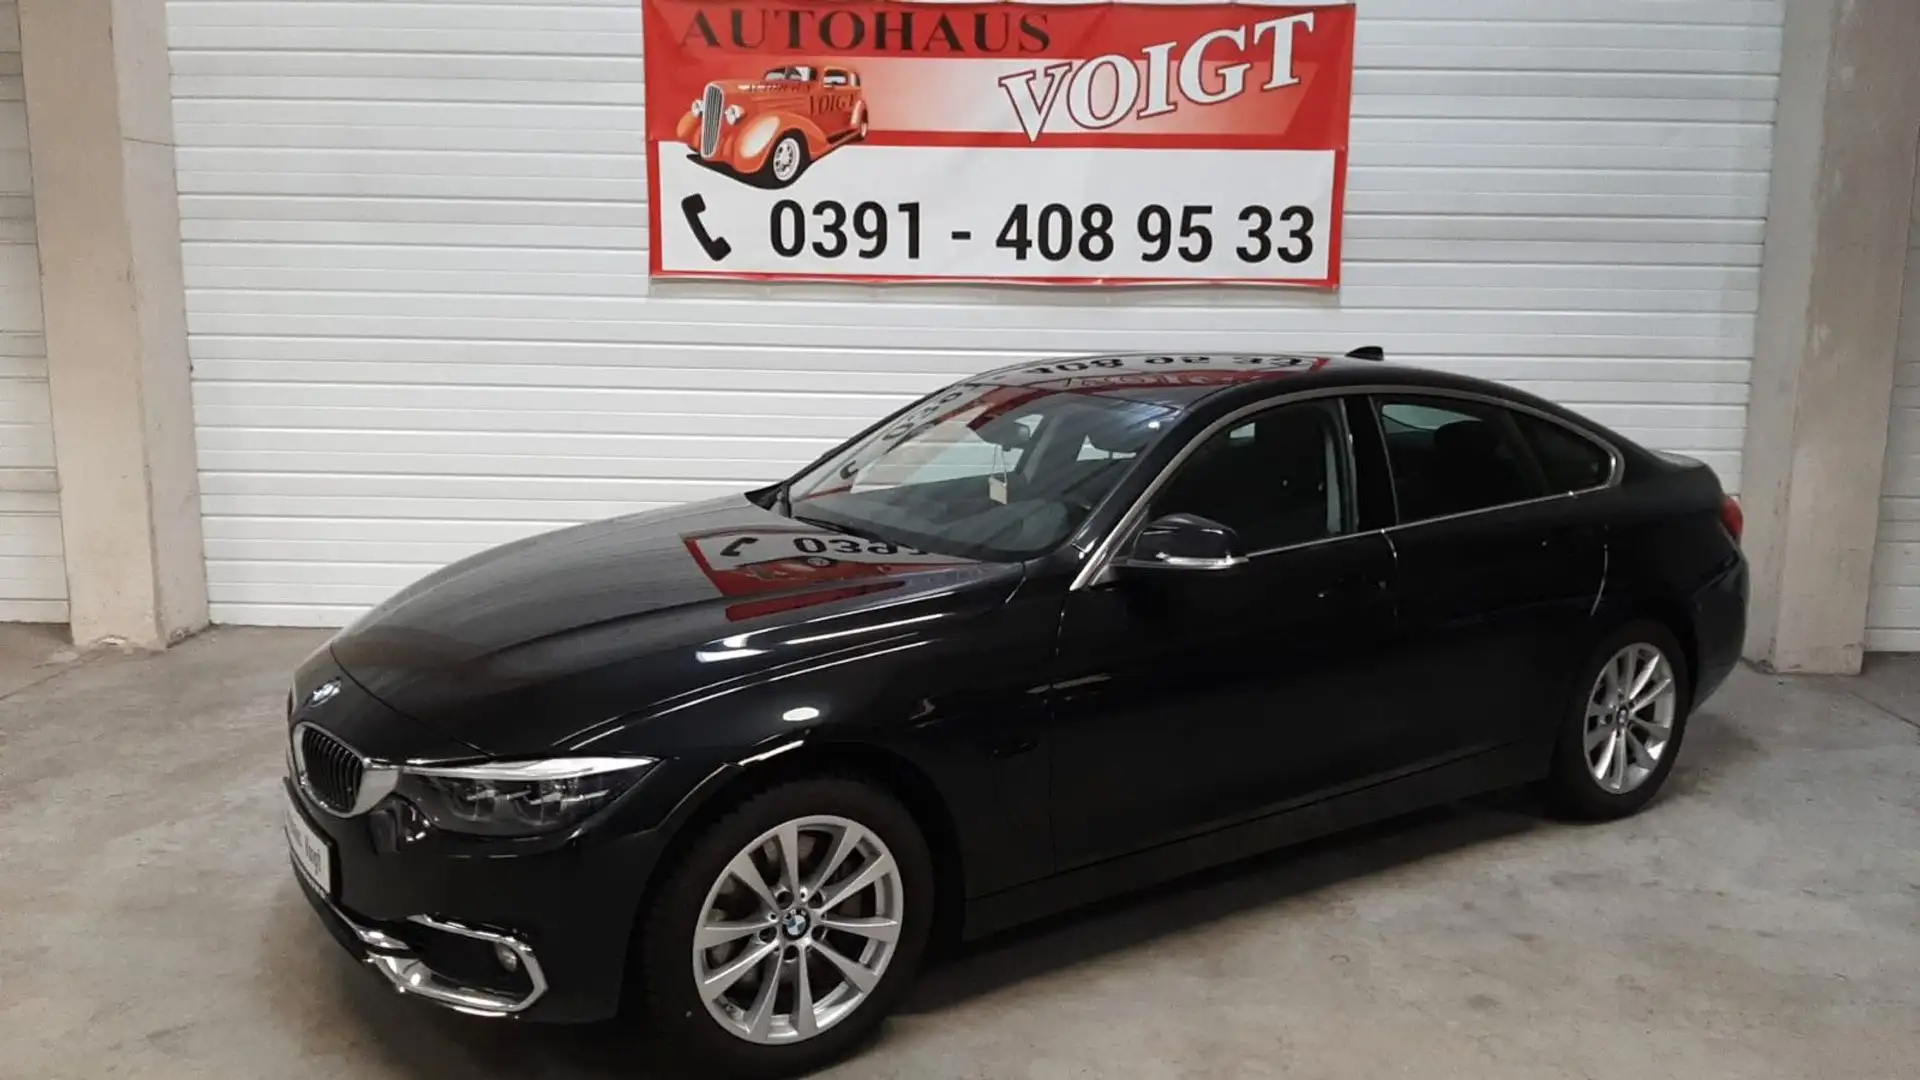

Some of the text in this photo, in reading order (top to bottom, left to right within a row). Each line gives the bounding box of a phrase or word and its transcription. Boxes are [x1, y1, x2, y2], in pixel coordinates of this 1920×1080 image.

[680, 9, 1050, 53] AUTOHAUS
[998, 12, 1315, 143] VOIGT
[770, 200, 920, 259] 0391
[996, 203, 1114, 262] 408
[1137, 204, 1213, 263] 95
[1236, 205, 1314, 264] 33
